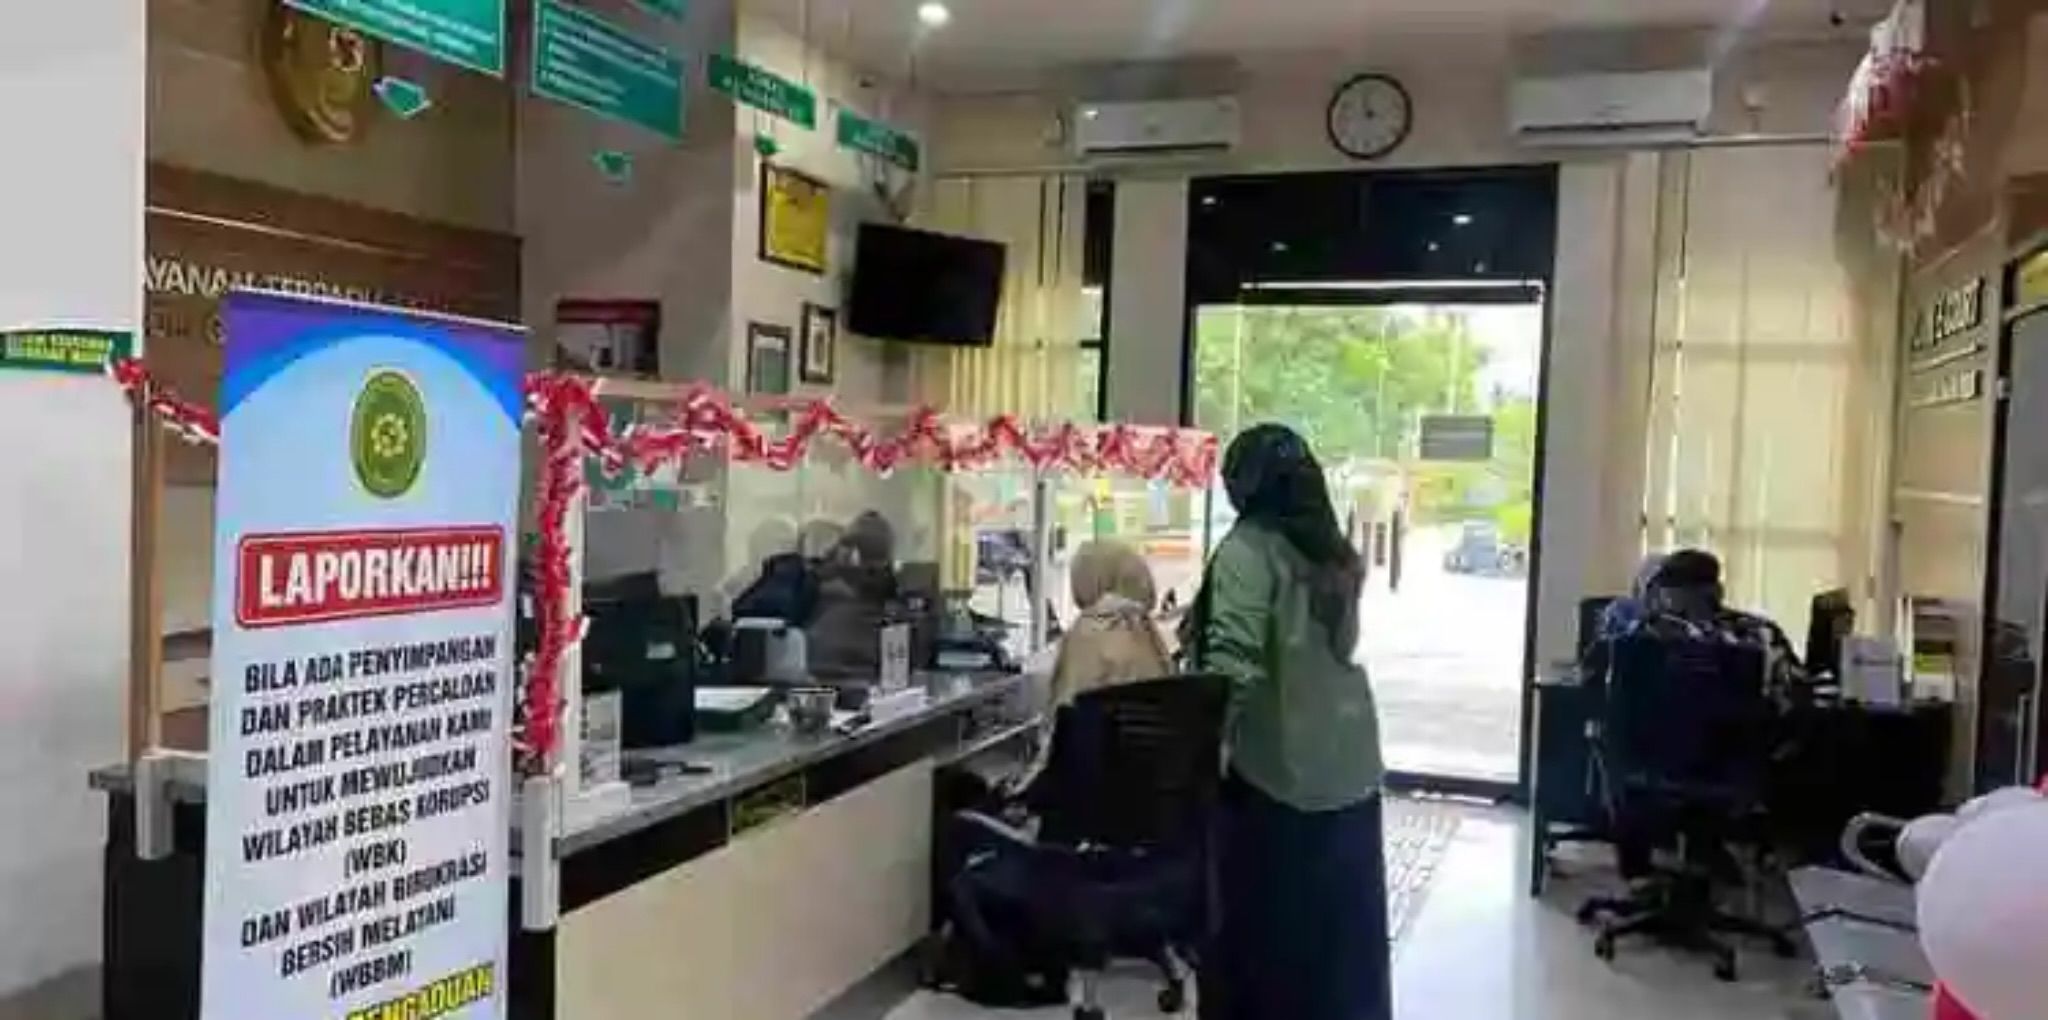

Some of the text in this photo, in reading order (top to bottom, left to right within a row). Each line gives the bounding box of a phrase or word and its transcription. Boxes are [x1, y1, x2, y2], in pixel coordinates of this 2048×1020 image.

[259, 545, 491, 607] LAPORKAN!!!
[245, 636, 496, 694] BILA ADA PENYIMPANGAN
[241, 672, 496, 735] DAN PRAKTEK PERCALOAN
[245, 709, 493, 778] DALAM PELAYANAN KAMI
[266, 747, 476, 816] UNTUK MEWUJUDKAN
[242, 780, 490, 862] WILAYAH BEBAS KORUPSI
[344, 838, 405, 879] (WBK)
[241, 852, 487, 947] DAN WILAYAH BIROKRASI
[281, 898, 455, 978] BERSIH MELAYANI
[330, 949, 411, 999] (WBBM)
